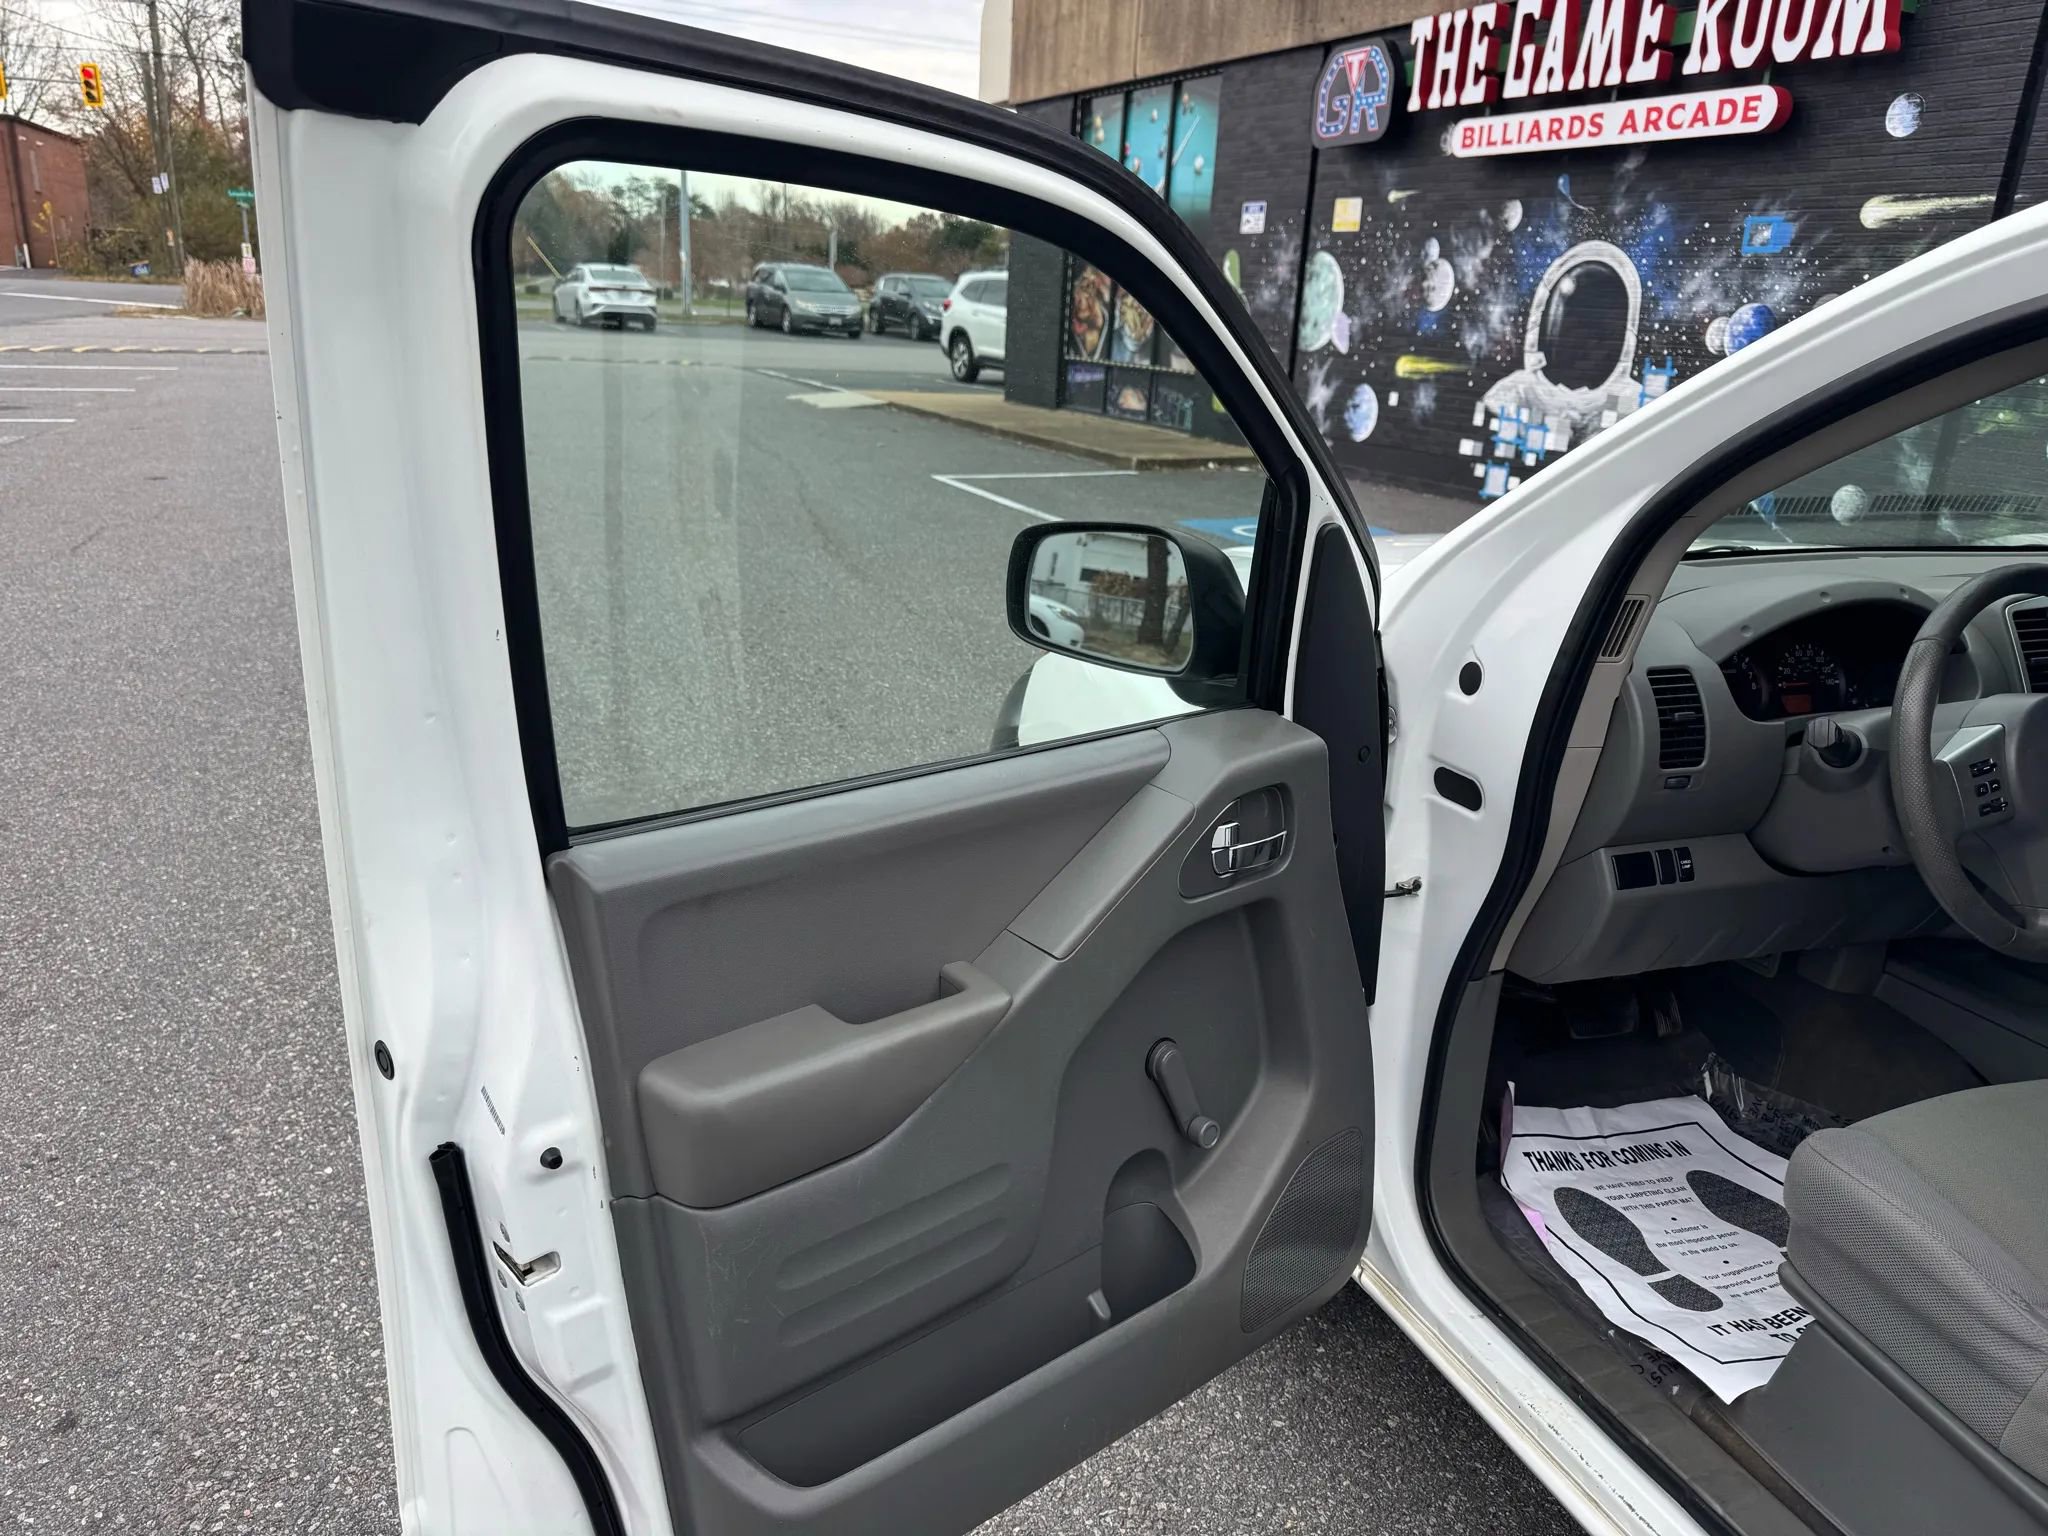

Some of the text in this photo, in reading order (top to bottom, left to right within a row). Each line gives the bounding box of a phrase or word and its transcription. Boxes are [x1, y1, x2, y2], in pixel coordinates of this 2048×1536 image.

[1406, 0, 1892, 113] THE GAME ROOM
[1460, 94, 1763, 150] BILLIARDS ARCADE
[1521, 1139, 1693, 1173] THANKS FOR COMING IN
[1645, 1178, 1656, 1186] TO
[1656, 1176, 1674, 1184] KEEP
[1605, 1186, 1689, 1202] YOUR CARPETING CLEAN
[1620, 1196, 1695, 1213] WITH THIS PAPER MAT
[1670, 1225, 1700, 1235] customer
[1668, 1239, 1686, 1247] most
[1685, 1234, 1717, 1246] important
[1716, 1230, 1740, 1240] person
[1688, 1248, 1701, 1256] the
[1701, 1245, 1720, 1254] world
[1702, 1259, 1775, 1281] Your suggestions for
[1713, 1278, 1751, 1291] improving
[1742, 1286, 1768, 1298] always
[1706, 1323, 1732, 1337] IT
[1726, 1318, 1768, 1333] HAS
[1761, 1306, 1812, 1330] BEEN
[1768, 1332, 1799, 1343] TO
